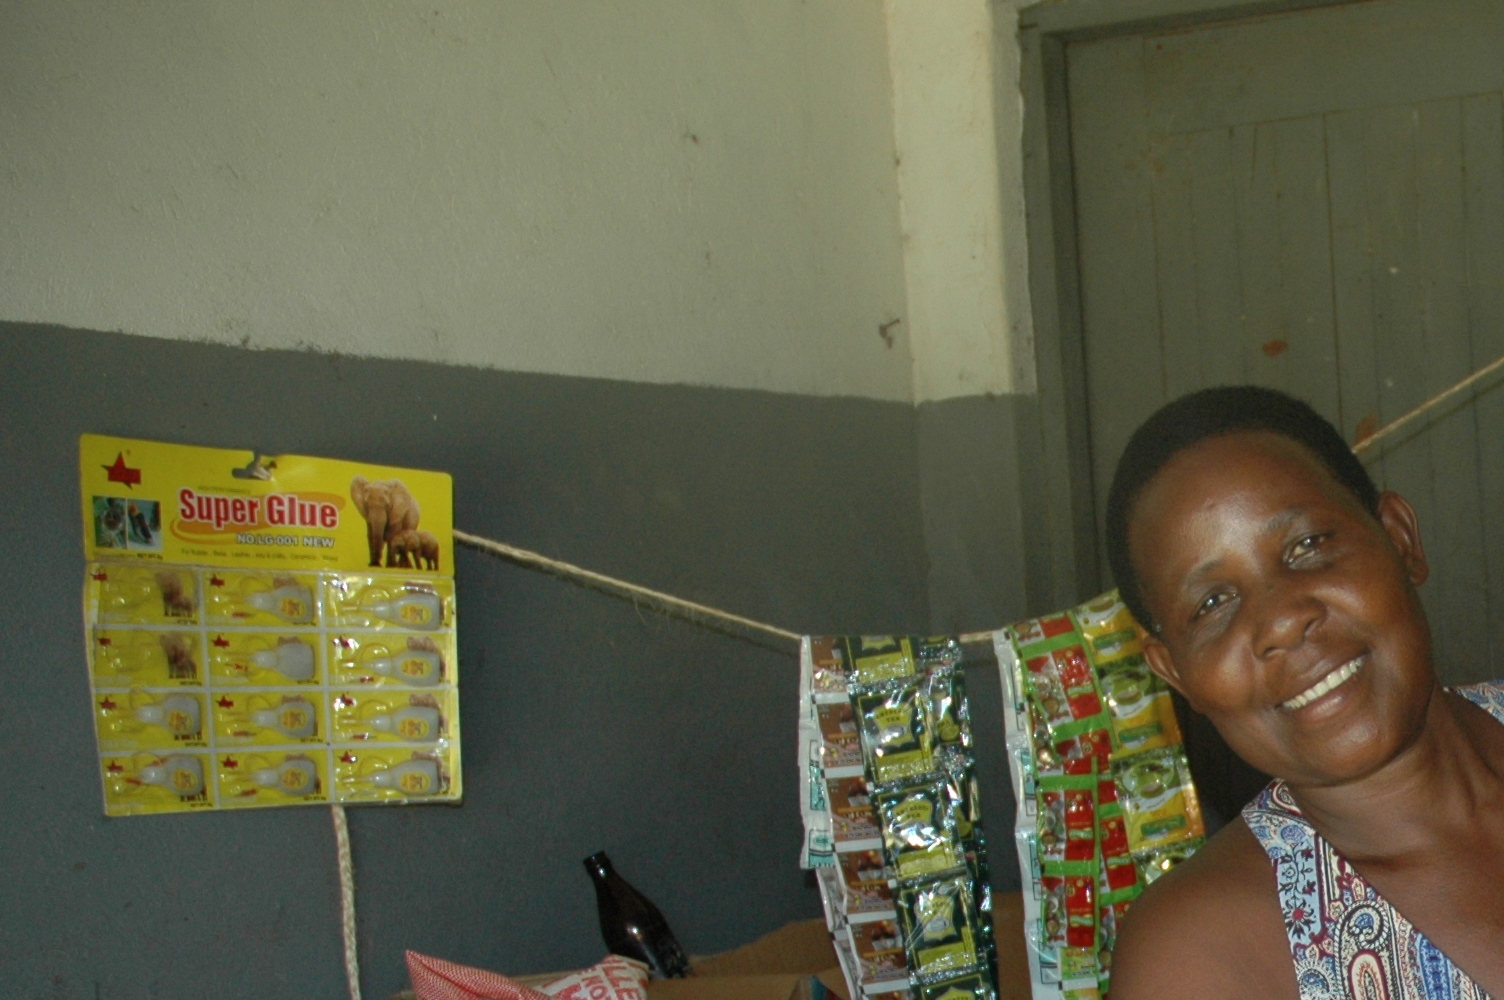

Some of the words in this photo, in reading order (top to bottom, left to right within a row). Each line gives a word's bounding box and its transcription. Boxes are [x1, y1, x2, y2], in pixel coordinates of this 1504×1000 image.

[180, 488, 259, 530] Super
[266, 495, 338, 528] Glue
[303, 537, 335, 549] NEW
